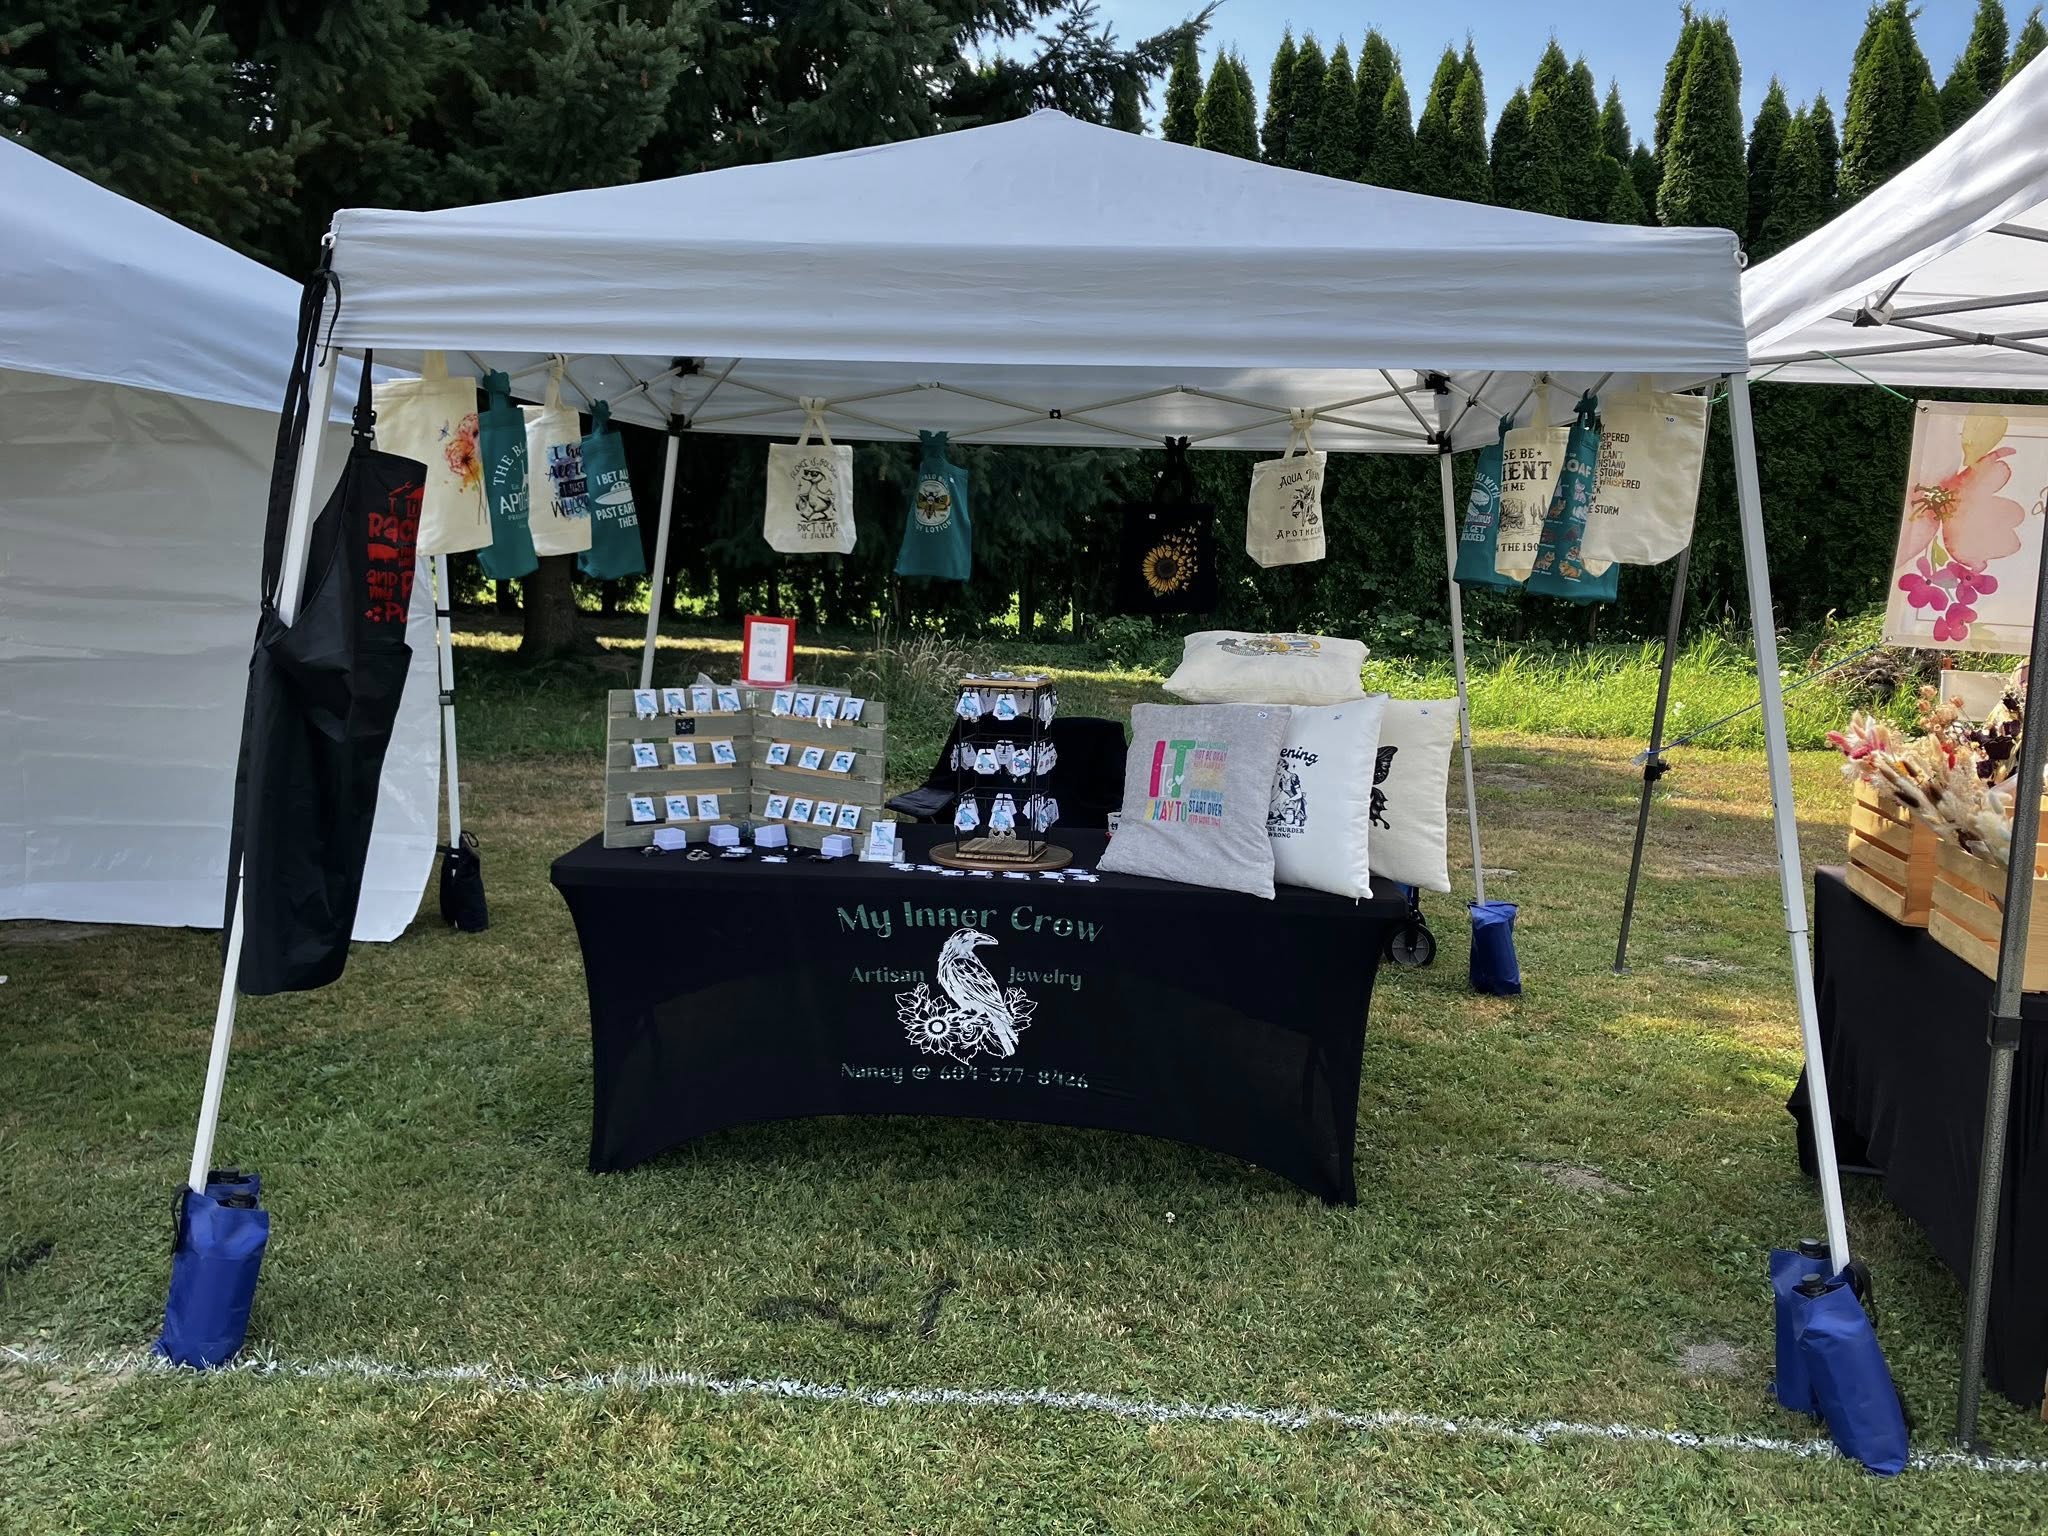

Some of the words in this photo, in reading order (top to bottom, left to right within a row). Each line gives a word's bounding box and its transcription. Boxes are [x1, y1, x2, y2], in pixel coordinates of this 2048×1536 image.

[1520, 448, 1535, 459] BE
[493, 455, 514, 486] THE
[512, 441, 527, 457] BL
[1562, 459, 1592, 477] OAF
[596, 475, 602, 486] I
[601, 470, 617, 485] BET
[1278, 472, 1303, 489] AQUA
[1511, 482, 1526, 491] ME
[595, 506, 617, 521] PAST
[1595, 504, 1620, 515] STORM
[1501, 543, 1520, 552] THE
[1280, 746, 1319, 767] ening
[1176, 801, 1188, 823] TO
[1188, 800, 1206, 814] START
[1208, 802, 1222, 817] OVER
[837, 904, 891, 938] My
[903, 901, 997, 928] Inner
[1011, 905, 1103, 941] Crow
[850, 966, 925, 983] Artisan
[1008, 966, 1082, 991] Jewelry
[841, 1062, 903, 1083] Nancy
[912, 1064, 931, 1080] @
